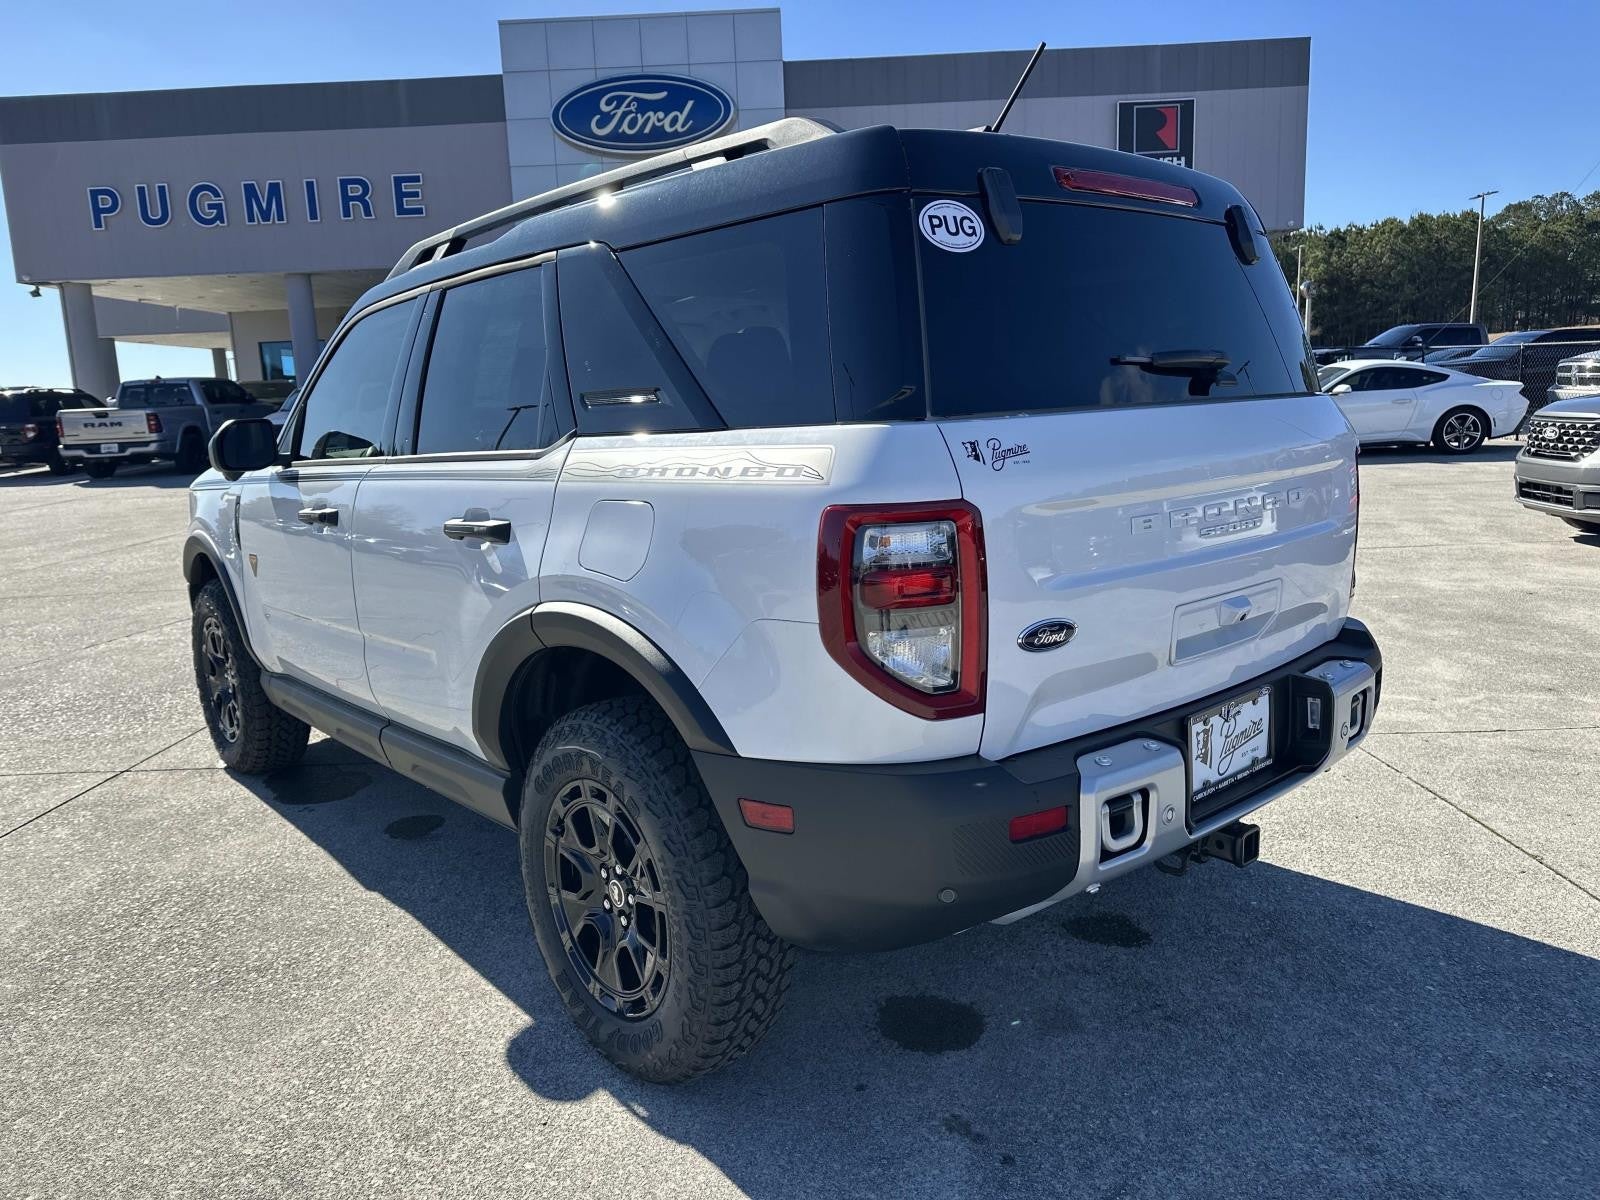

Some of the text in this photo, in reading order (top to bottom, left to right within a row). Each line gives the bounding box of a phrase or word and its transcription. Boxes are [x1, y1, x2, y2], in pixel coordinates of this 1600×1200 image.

[590, 91, 696, 136] Ford
[87, 173, 426, 231] PUGMIRE
[927, 214, 978, 238] PUG
[617, 466, 805, 478] BRONCO
[986, 437, 1031, 472] Pugmire
[1130, 486, 1303, 536] BRONCO
[1199, 516, 1263, 538] SPORT
[1034, 625, 1067, 645] Ford
[1217, 715, 1264, 776] Pugmire
